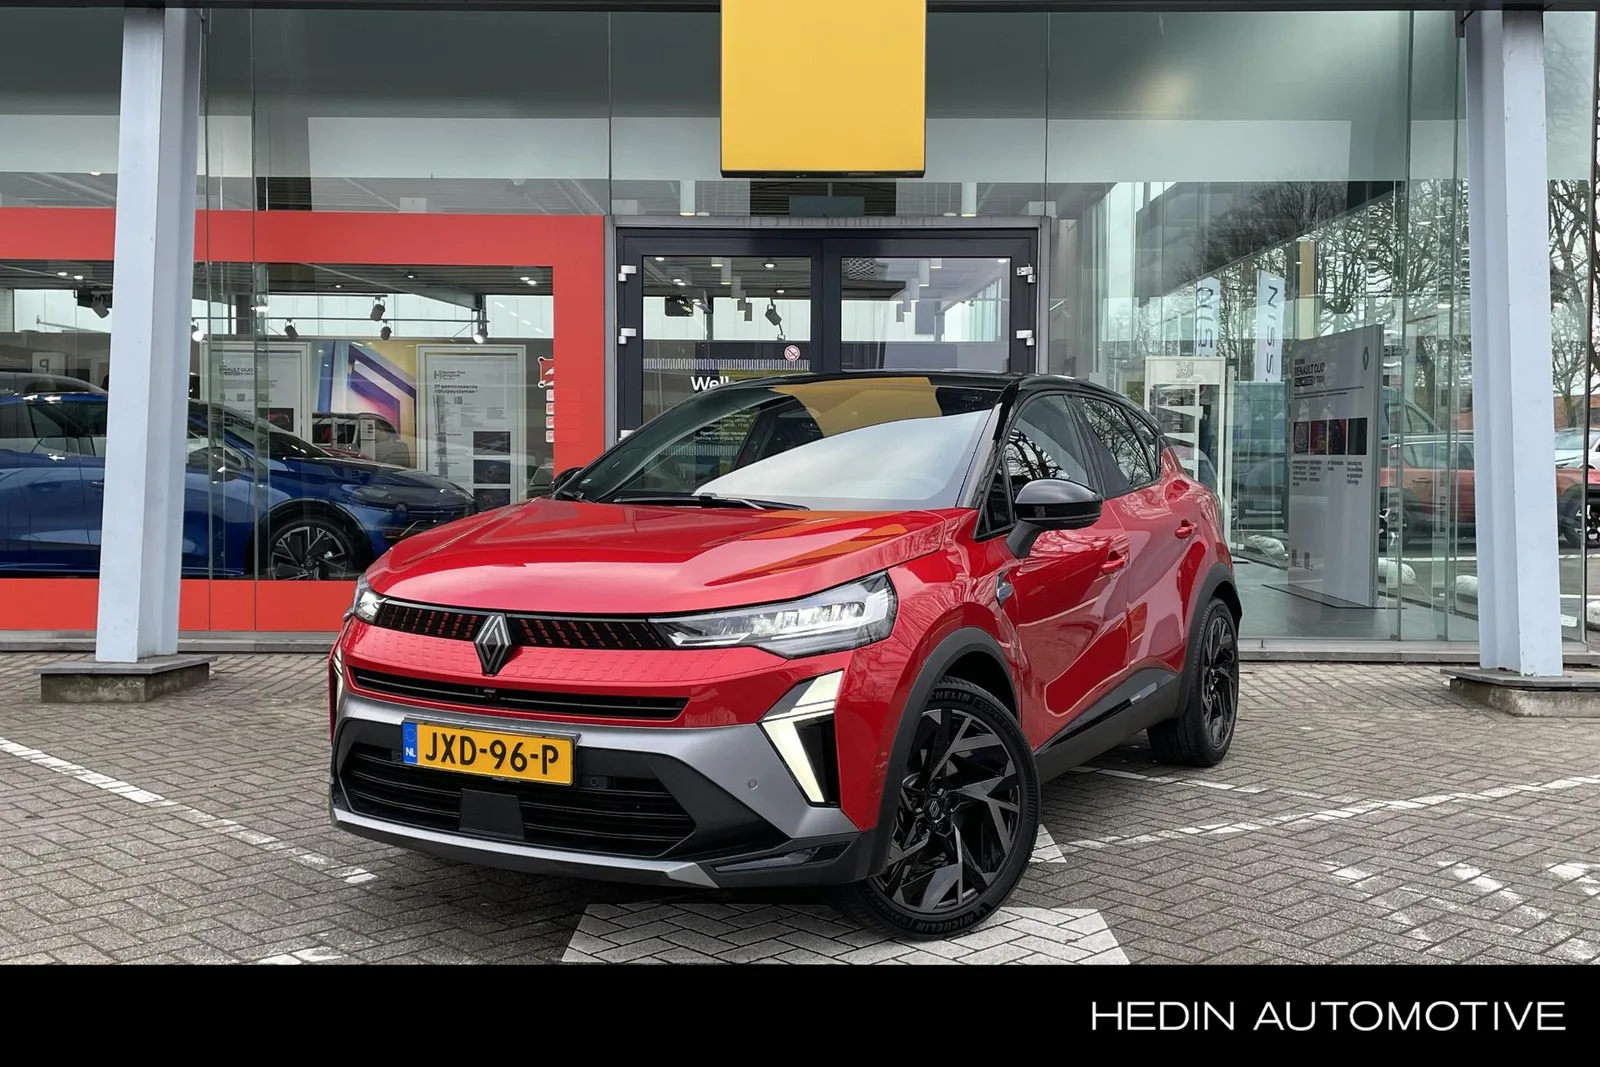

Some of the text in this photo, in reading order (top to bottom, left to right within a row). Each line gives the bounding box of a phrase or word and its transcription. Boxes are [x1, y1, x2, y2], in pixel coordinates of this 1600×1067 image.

[1265, 285, 1279, 382] NISS
[405, 747, 416, 758] NL
[425, 731, 559, 775] JXD-96-P
